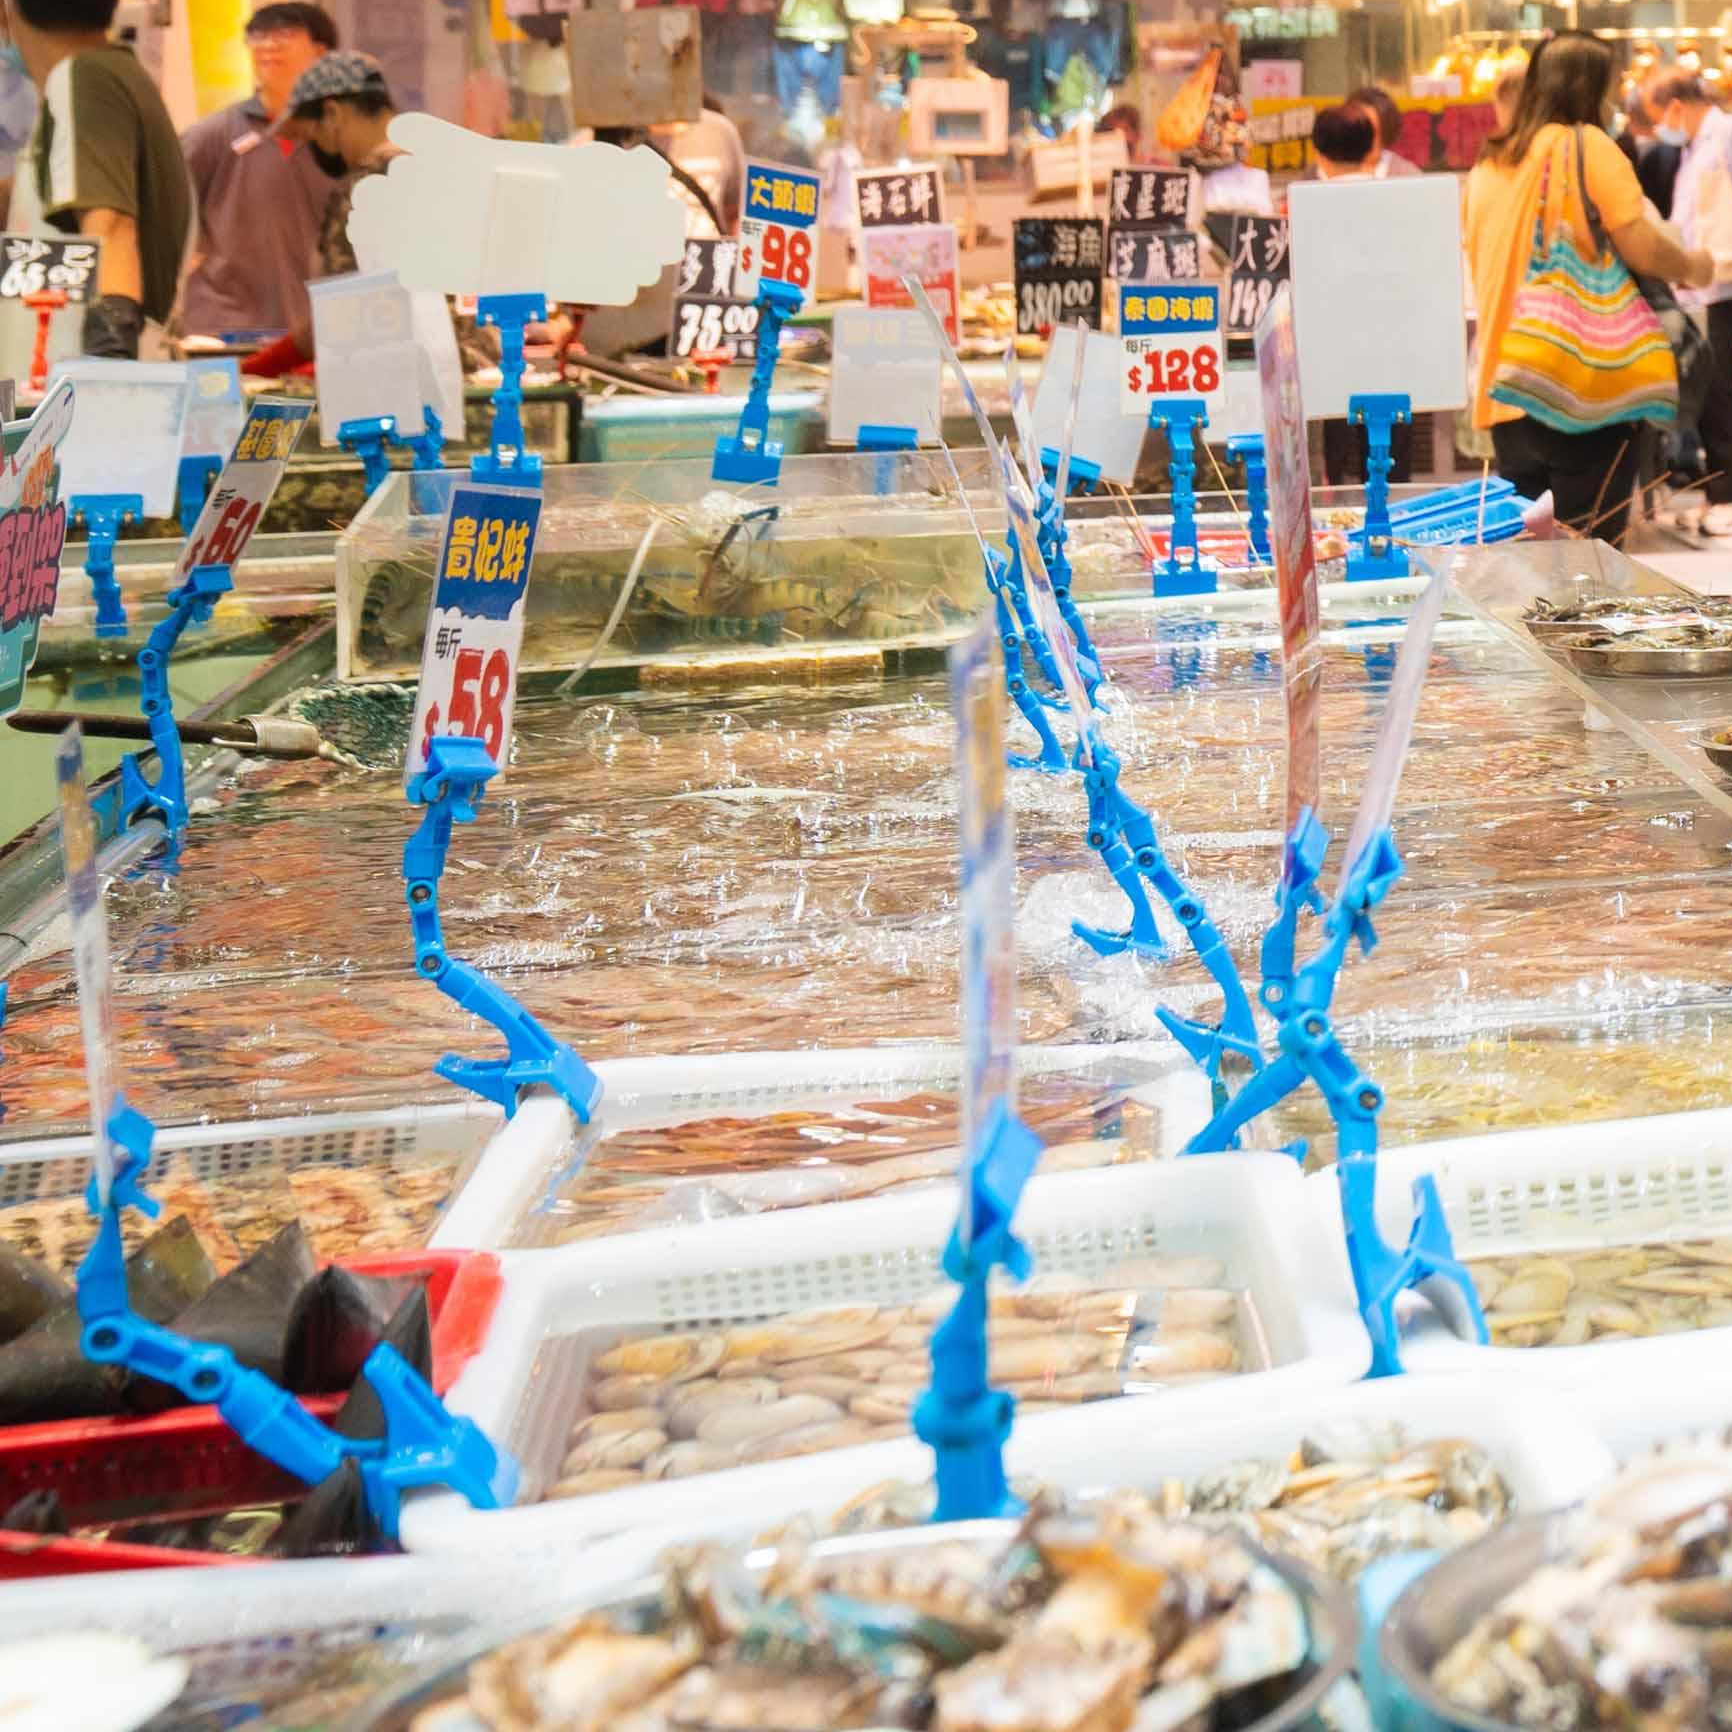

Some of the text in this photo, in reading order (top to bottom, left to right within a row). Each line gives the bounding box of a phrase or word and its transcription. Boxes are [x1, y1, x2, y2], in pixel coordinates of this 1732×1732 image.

[750, 175, 817, 217] 大頭蝦
[742, 223, 811, 289] $98
[1124, 295, 1215, 322] 泰國海蝦
[1128, 344, 1220, 393] $128
[422, 648, 509, 762] $58
